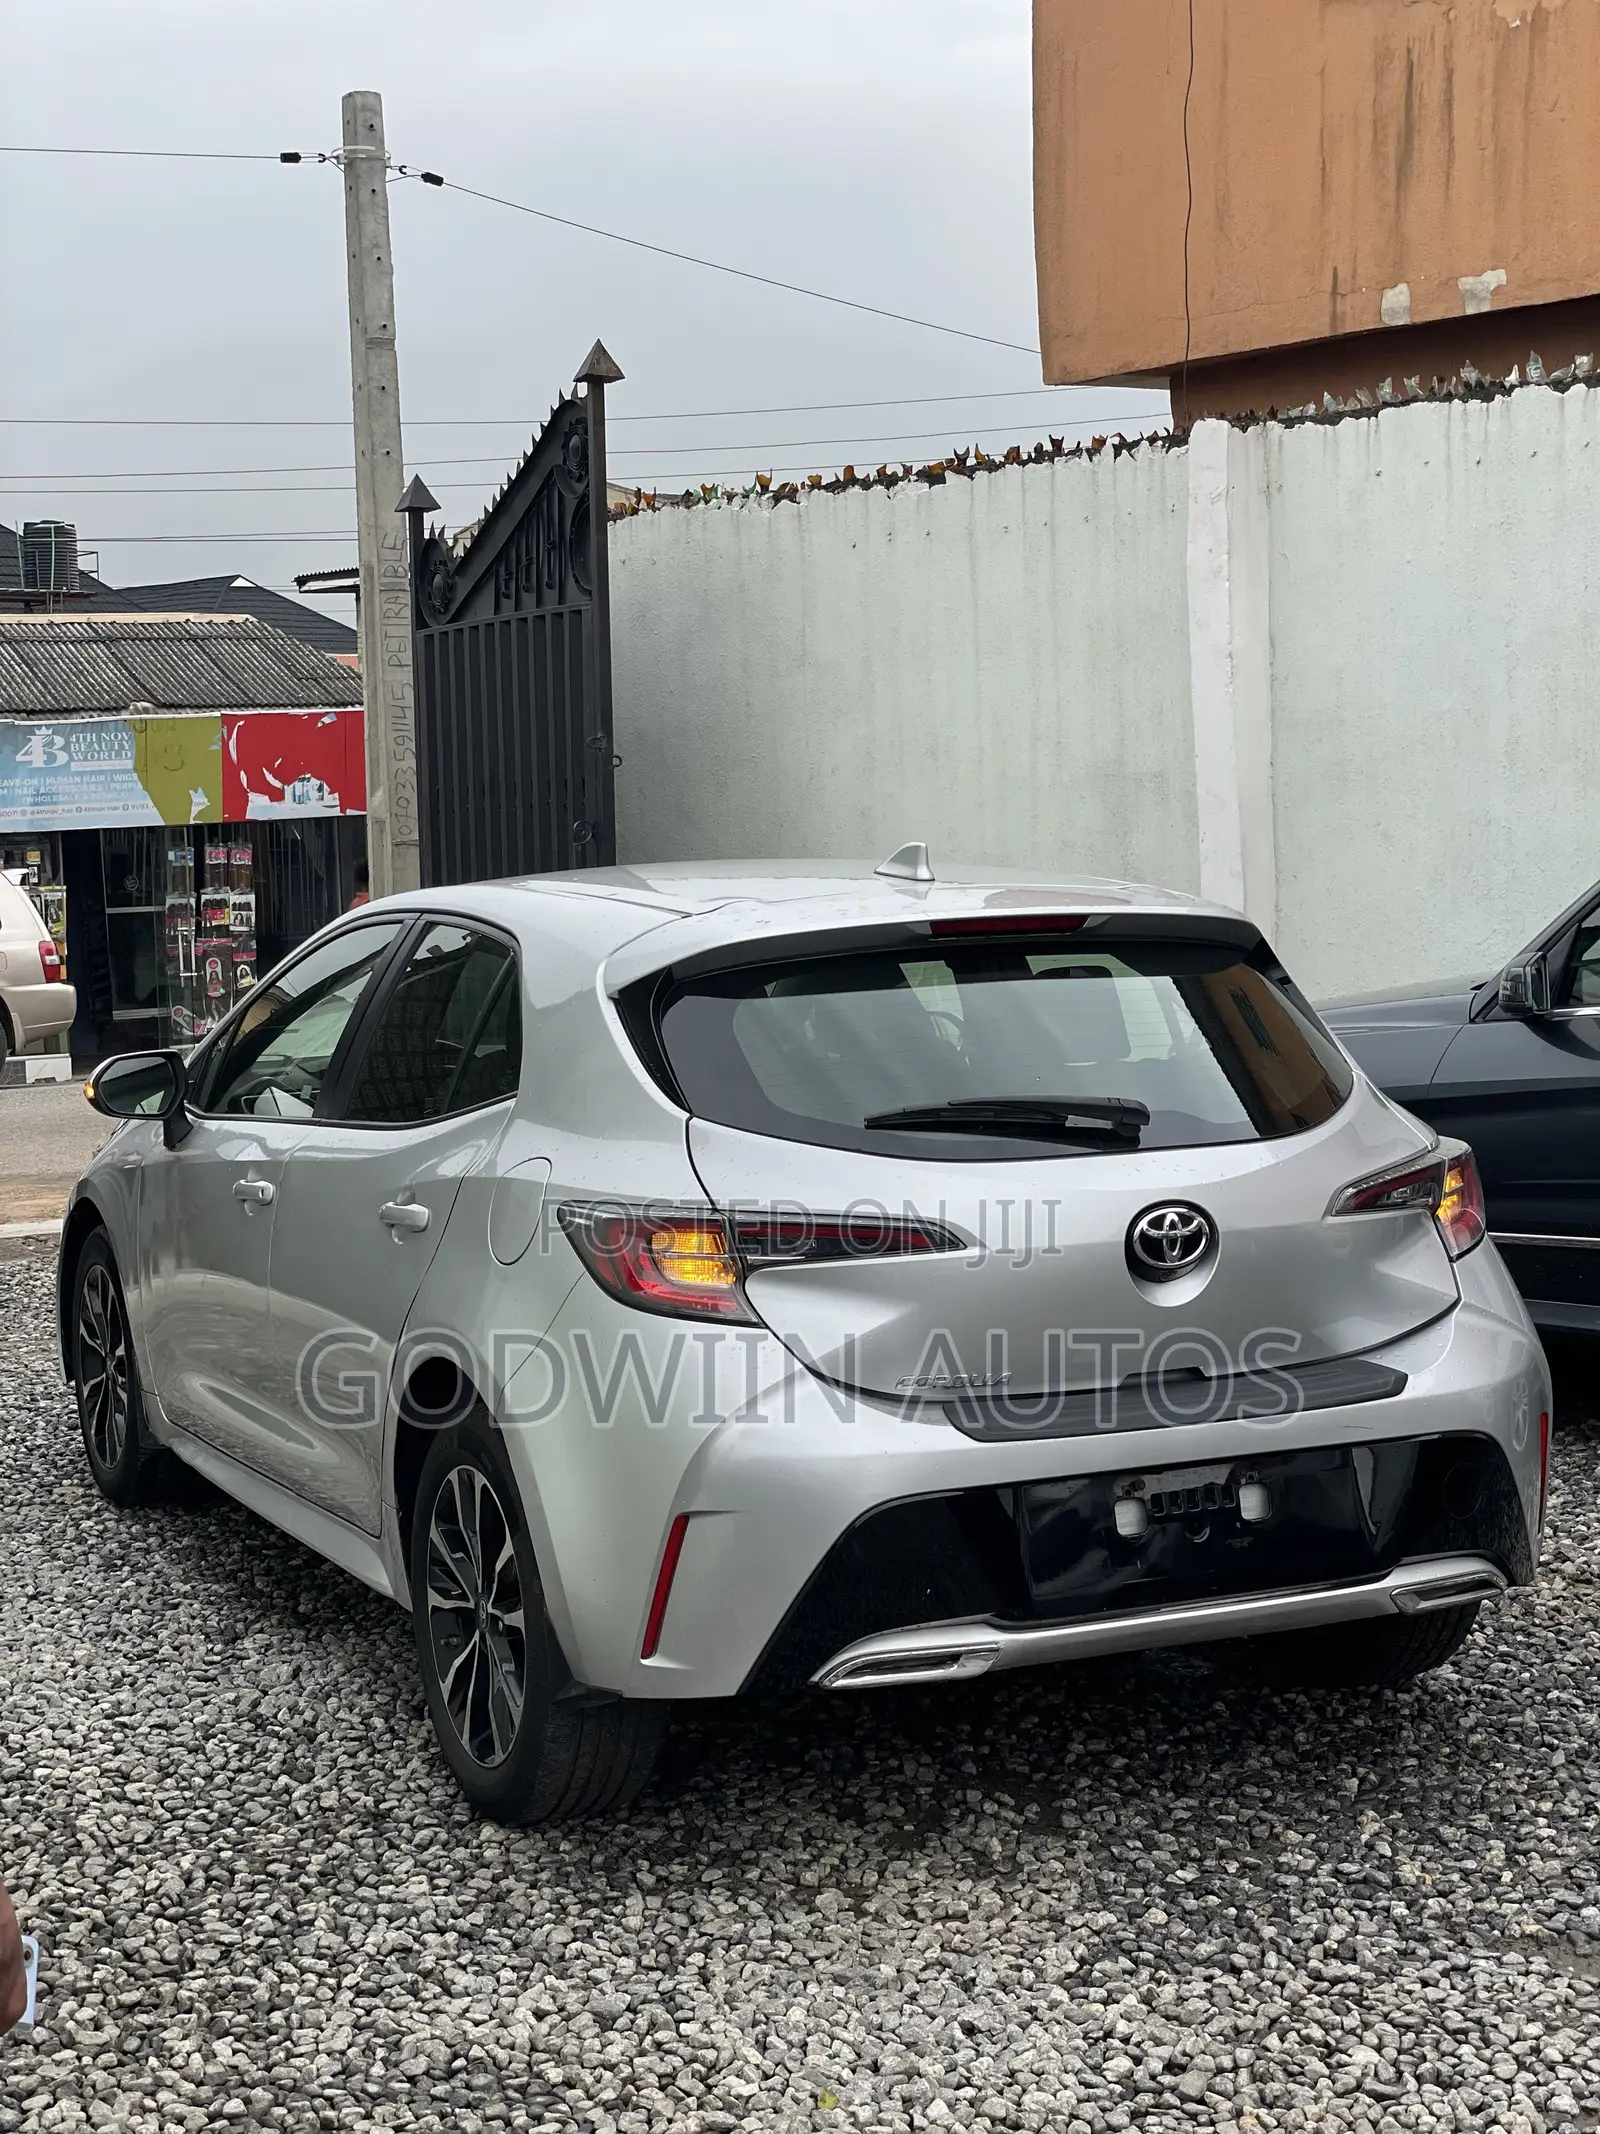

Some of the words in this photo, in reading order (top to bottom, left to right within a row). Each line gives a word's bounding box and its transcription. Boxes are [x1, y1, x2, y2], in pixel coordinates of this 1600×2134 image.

[69, 733, 97, 743] 4TH
[100, 732, 132, 742] NOV
[70, 741, 132, 752] BEAUTY
[72, 750, 132, 761] WORLD
[46, 776, 81, 786] HUMAN
[83, 774, 106, 784] HAIR
[113, 773, 138, 782] WIGS
[15, 787, 37, 796] NAIL
[895, 1372, 1012, 1390] COROLLA
